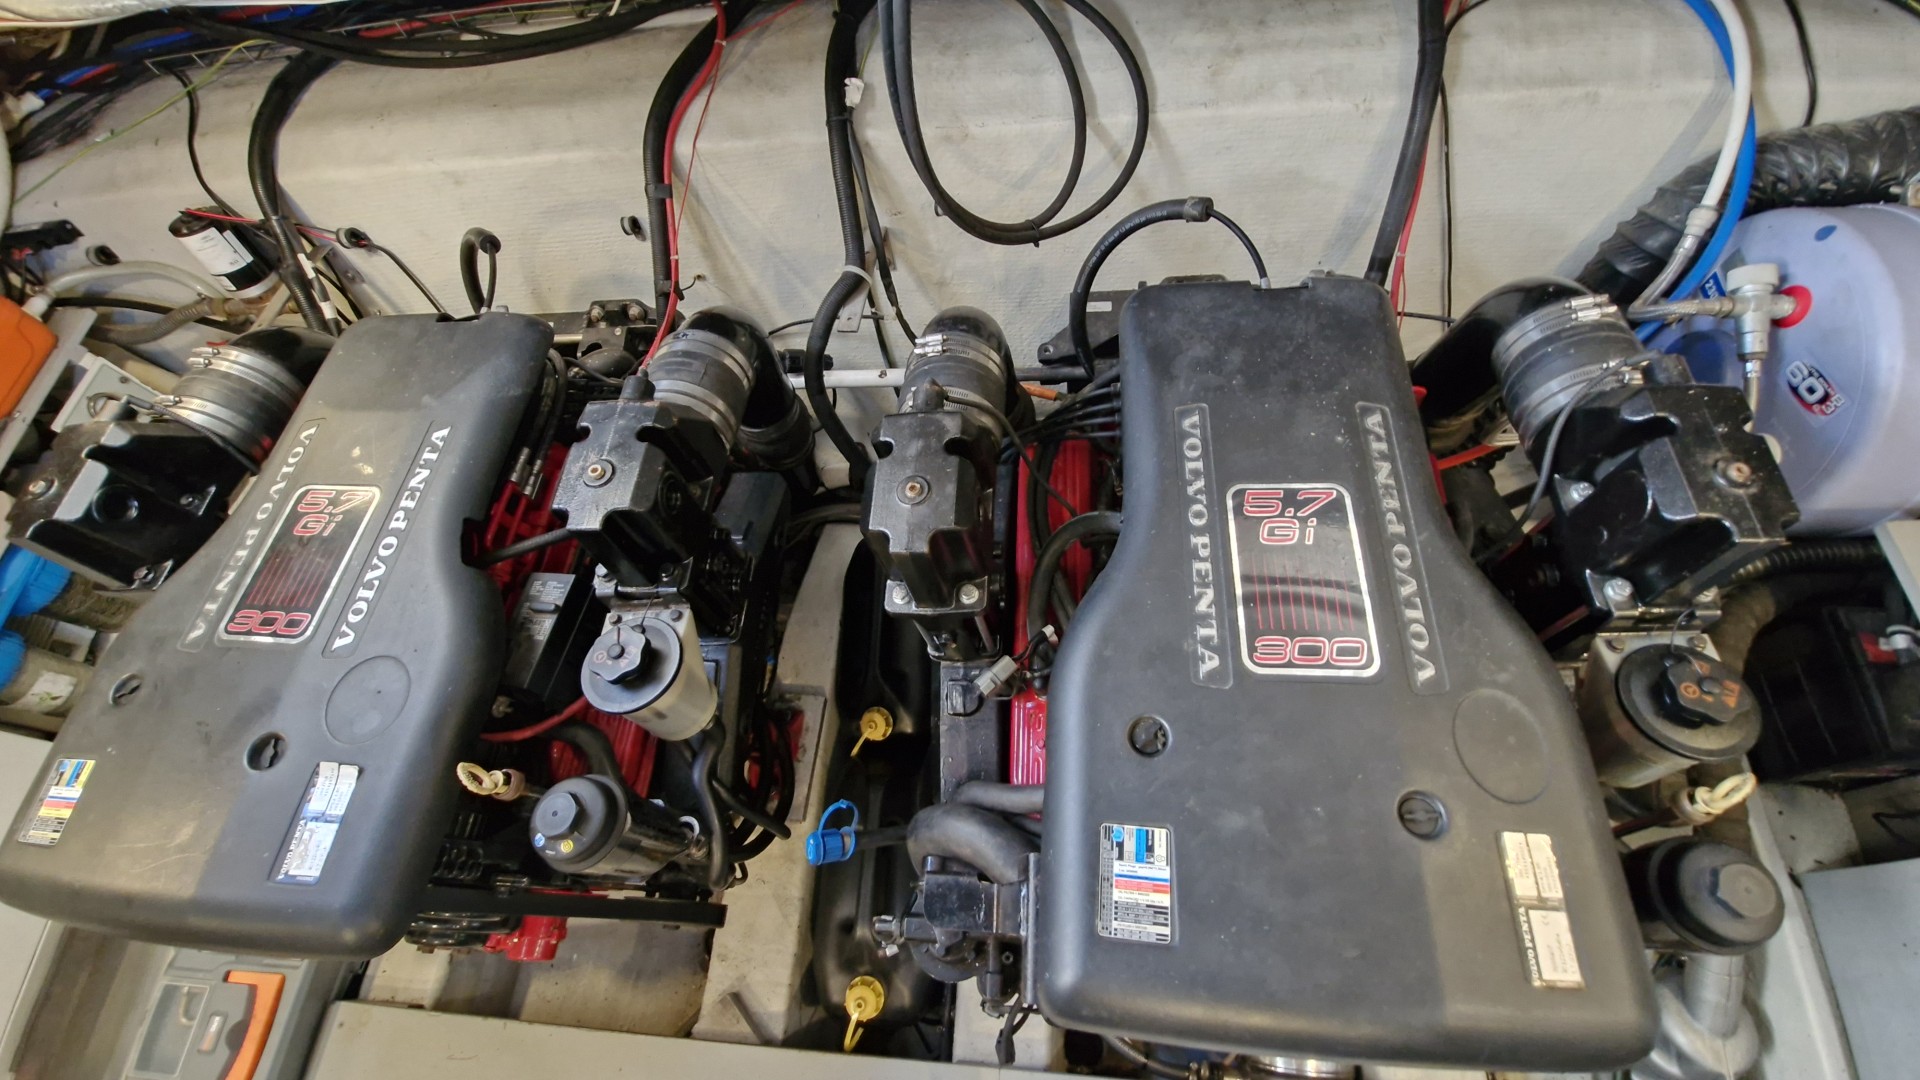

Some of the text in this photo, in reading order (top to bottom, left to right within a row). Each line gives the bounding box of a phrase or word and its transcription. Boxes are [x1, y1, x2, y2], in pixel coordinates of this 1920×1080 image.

[1785, 360, 1826, 404] 60
[297, 491, 374, 514] 5.7
[1243, 490, 1337, 516] 5.7
[185, 424, 318, 643] VOLVO PENTA
[293, 514, 343, 536] Gi
[331, 426, 451, 651] VOLVO PENTA
[1182, 411, 1220, 680] VOLVO PENTA
[1260, 518, 1317, 544] Gi
[1365, 412, 1436, 688] VOLVO PENTA
[227, 610, 312, 635] 300
[1253, 636, 1367, 666] 300
[275, 819, 307, 880] VOLVO PENTA
[1518, 906, 1533, 948] PENTA
